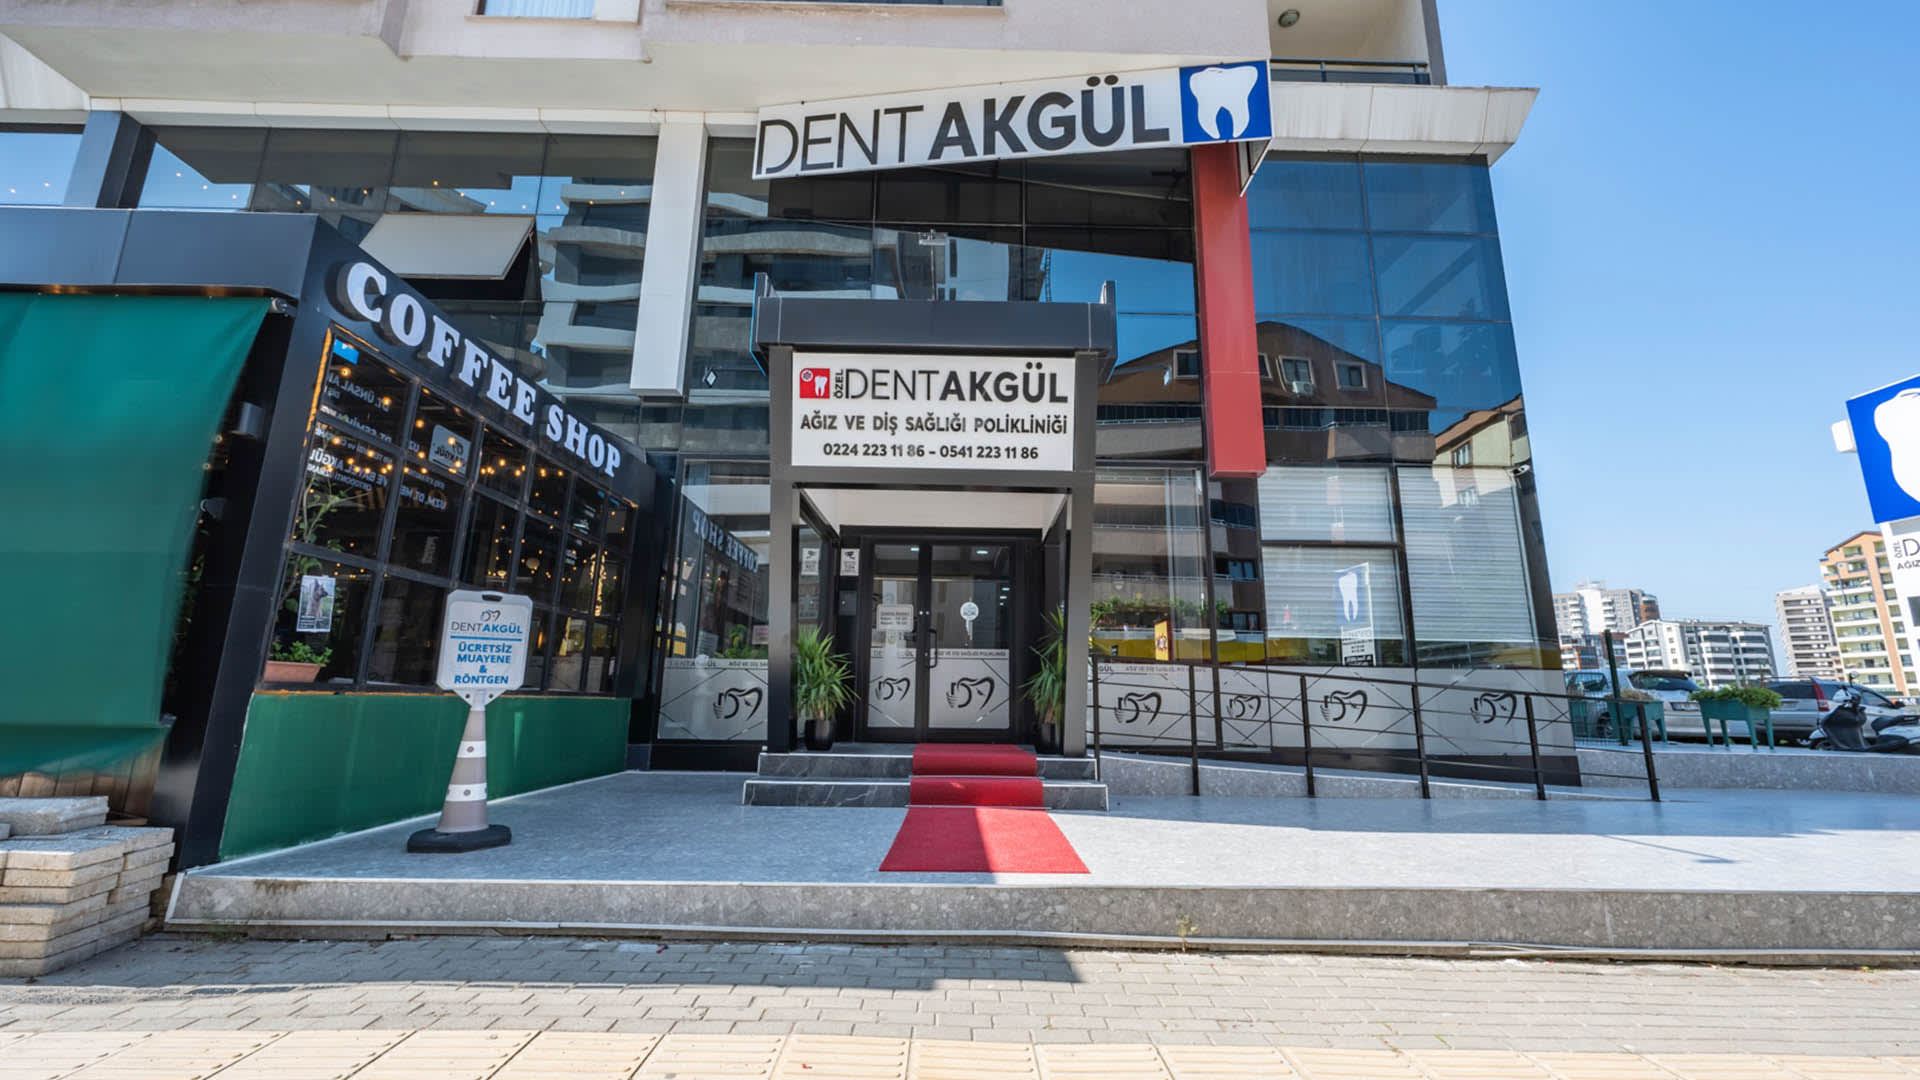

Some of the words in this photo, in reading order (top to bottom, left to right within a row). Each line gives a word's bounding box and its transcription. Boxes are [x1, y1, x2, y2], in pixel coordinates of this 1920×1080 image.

[347, 262, 536, 426] COFFEE
[545, 403, 621, 478] SHOP
[833, 368, 844, 399] ÖZEL
[800, 409, 837, 430] AĞIZ
[844, 415, 865, 430] VE
[872, 412, 898, 435] DİŞ
[905, 412, 966, 432] SAĞLIĞI
[974, 413, 1068, 435] POLİKLİNİĞİ
[823, 443, 858, 456] 0224
[862, 443, 887, 457] 223
[890, 444, 903, 457] 11
[907, 444, 925, 457] 86
[939, 445, 972, 459] 0541
[976, 446, 1001, 459] 223
[1004, 446, 1017, 459] 11
[1021, 447, 1039, 460] 86
[458, 641, 512, 654] ÜCRETSİZ
[456, 654, 511, 664] MUAYENE
[479, 665, 487, 673] &
[454, 673, 509, 684] RÖNTGEN
